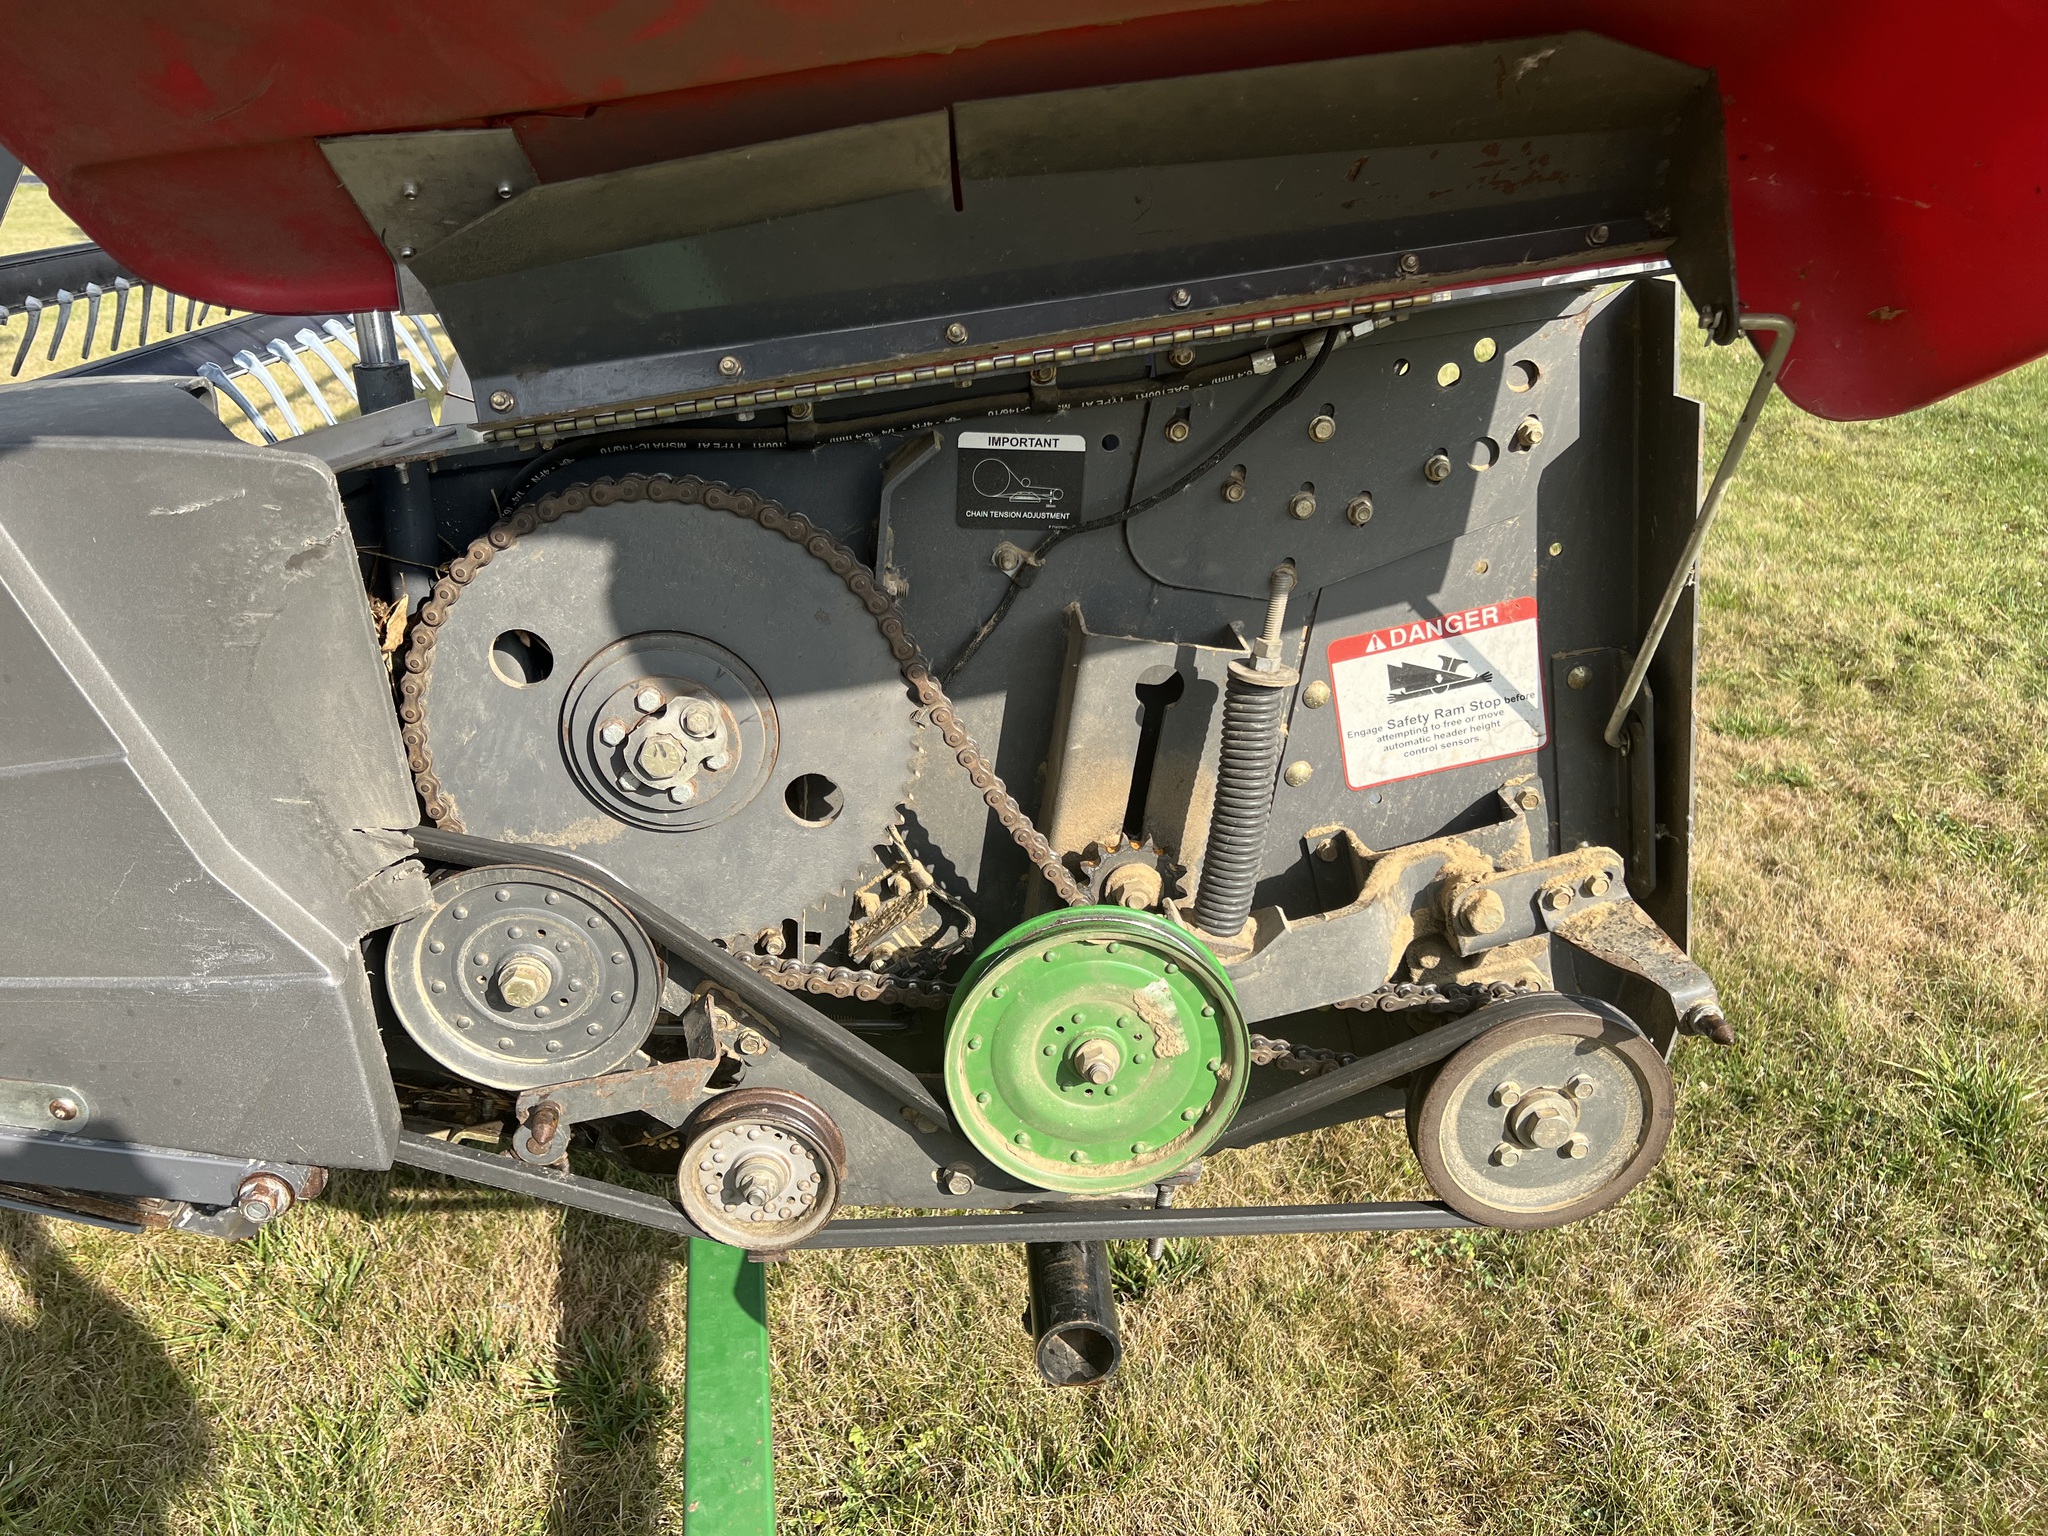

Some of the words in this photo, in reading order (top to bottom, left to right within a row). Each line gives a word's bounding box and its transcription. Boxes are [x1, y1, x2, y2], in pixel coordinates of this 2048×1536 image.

[988, 436, 1059, 448] IMPORTANT
[965, 510, 988, 518] CHAIN
[1023, 512, 1070, 520] ADJUSTMENT
[1390, 606, 1499, 647] DANGER
[1347, 726, 1383, 739] Engage
[1387, 712, 1430, 730] Safety
[1435, 705, 1465, 719] Ram
[1470, 698, 1501, 715] Stop
[1504, 692, 1535, 704] before
[1376, 725, 1429, 743] attempting
[1431, 722, 1440, 731] to
[1443, 718, 1462, 728] free
[1465, 715, 1475, 724] or
[1478, 709, 1504, 721] move
[1383, 734, 1431, 752] automatic
[1434, 727, 1467, 740] header
[1470, 720, 1501, 736] height
[1403, 743, 1438, 758] control
[1440, 736, 1482, 751] sensors.
